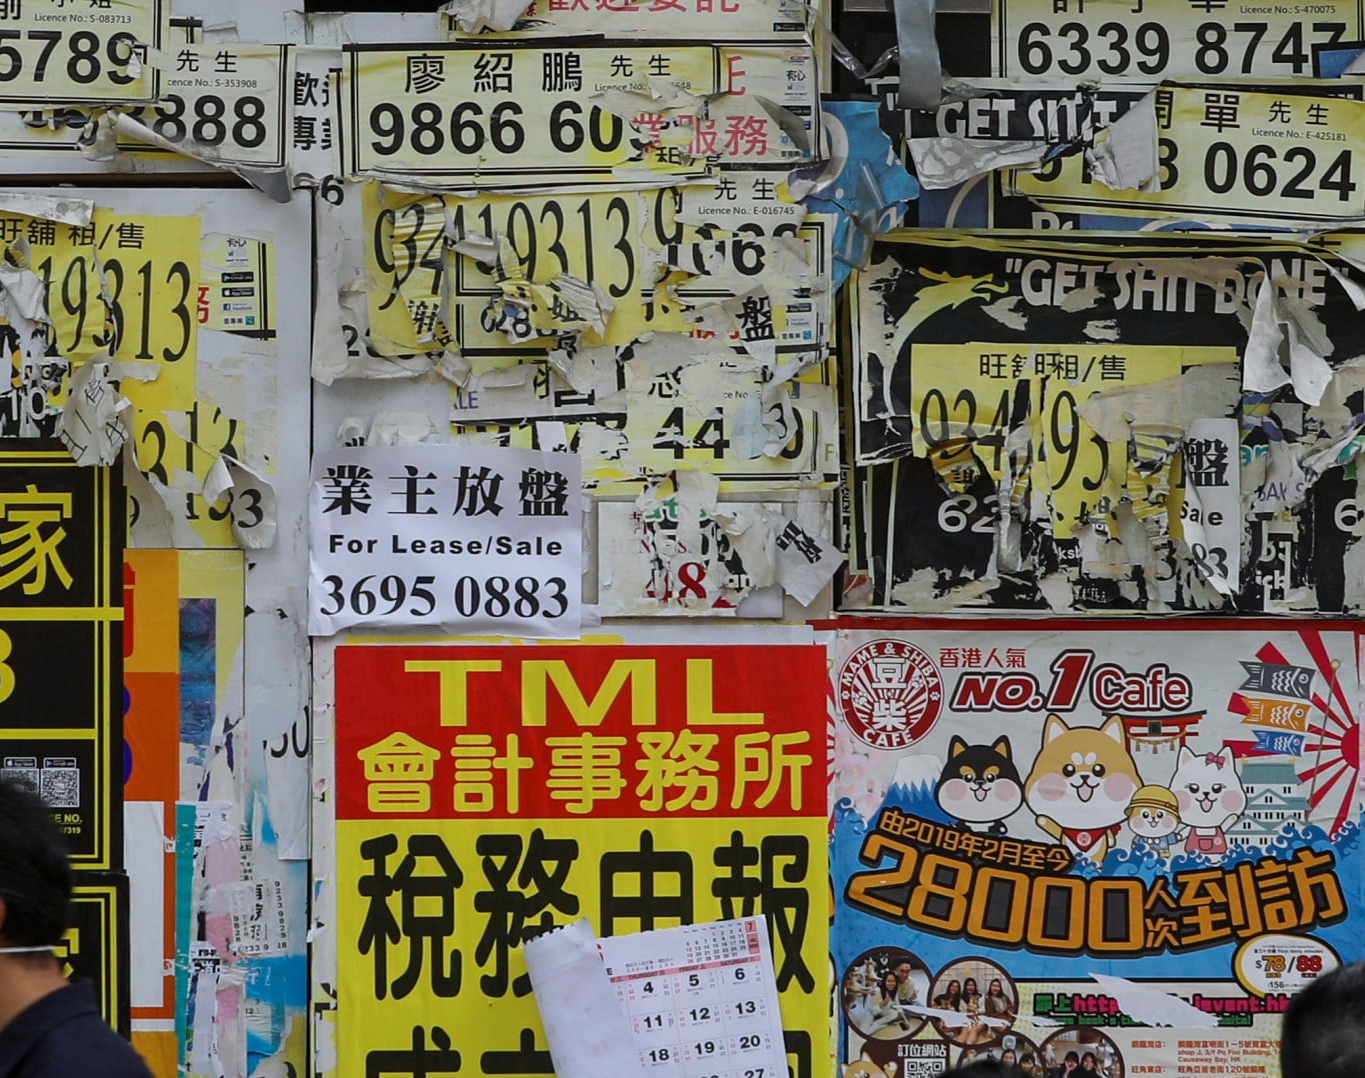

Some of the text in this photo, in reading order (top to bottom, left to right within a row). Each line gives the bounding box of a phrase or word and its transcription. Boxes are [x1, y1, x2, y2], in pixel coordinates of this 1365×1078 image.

[35, 14, 132, 24] Licence S-083713
[1240, 6, 1335, 14] Licence S-470075
[177, 49, 237, 73] 先生
[1018, 22, 1170, 75] 6339
[405, 51, 671, 94] 廖紹鵬 先生
[370, 102, 525, 154] 9866
[1252, 128, 1346, 141] Licence E-425181
[1269, 101, 1329, 125] 先生
[1204, 142, 1357, 201] 0624
[699, 206, 795, 215] Licence E-016745
[321, 463, 569, 518] 業主放盤
[328, 534, 562, 557] For Lease/Sale
[320, 574, 568, 617] 3695 0883
[940, 648, 1026, 668] 香港人氣
[404, 658, 764, 727] TML
[1091, 665, 1192, 709] Cafe
[357, 730, 811, 815] 會計事務所
[880, 808, 1070, 871] 由2019年2月至今
[848, 833, 1145, 952] 28000
[643, 968, 745, 994] 4 5 6
[644, 1002, 756, 1029] 11 12 13
